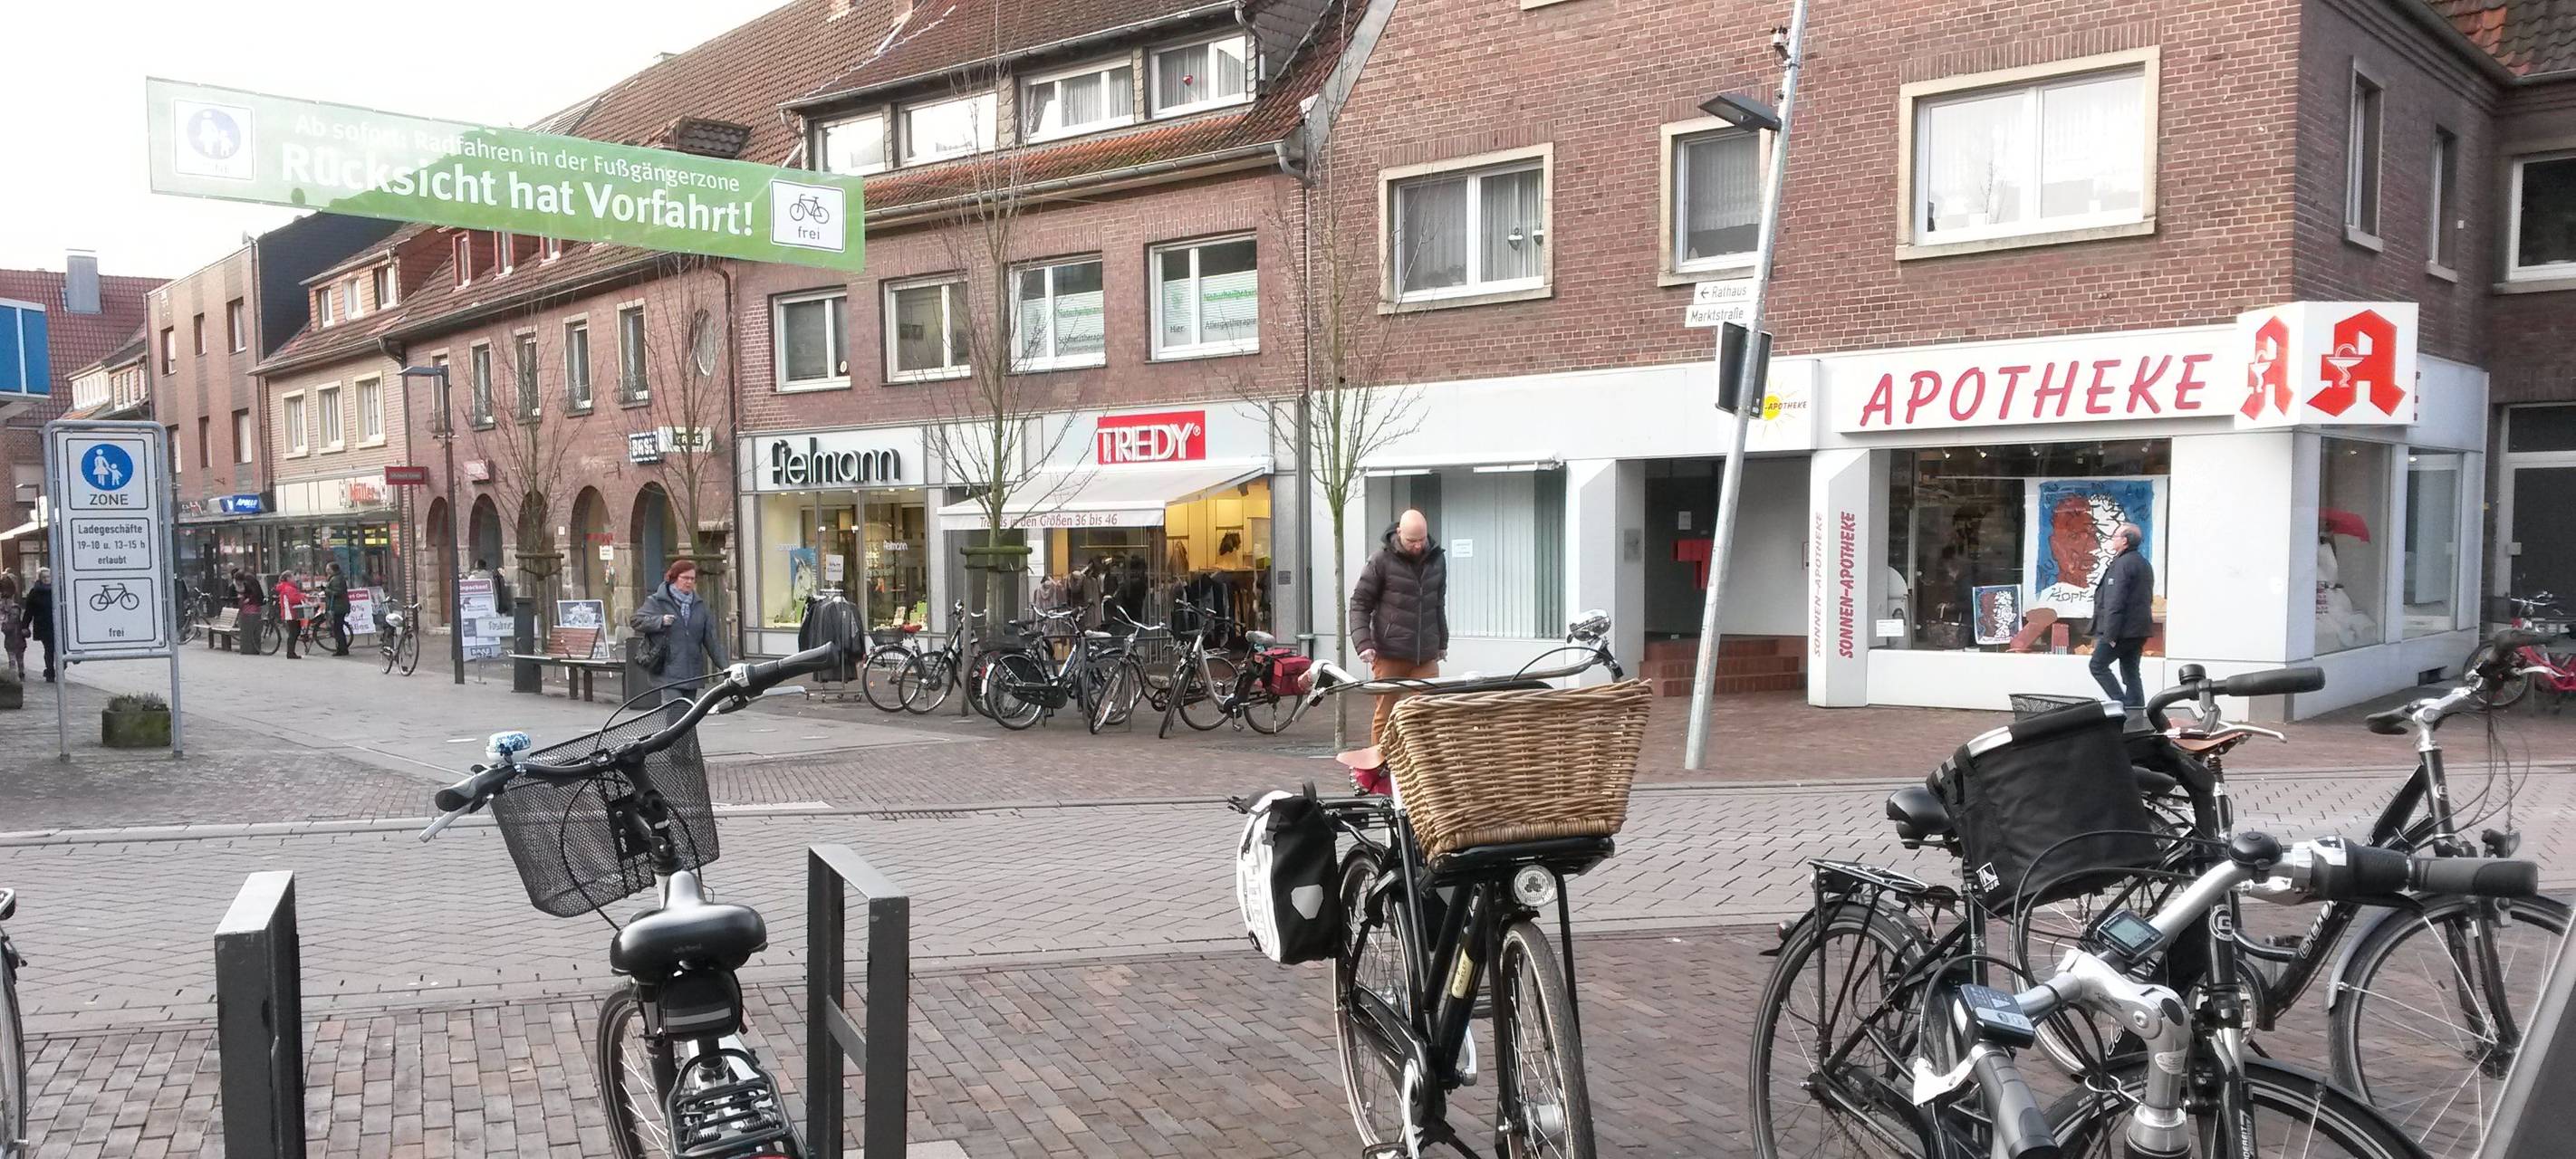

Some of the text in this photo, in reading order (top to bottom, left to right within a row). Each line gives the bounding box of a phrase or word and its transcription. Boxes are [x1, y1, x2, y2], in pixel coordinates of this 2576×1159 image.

[295, 113, 327, 138] Ab
[414, 129, 524, 164] Radfahren
[530, 145, 550, 168] in
[555, 148, 588, 172] der
[593, 154, 741, 193] Fußgängerzone
[281, 142, 754, 238] Rücksicht hat Vorfahrt!
[796, 226, 821, 241] frei
[1711, 285, 1747, 299] Rathaus
[1690, 307, 1745, 322] Marktstraße
[1860, 353, 2215, 427] APOTHEKE
[772, 436, 901, 485] fielmann
[89, 493, 130, 506] ZONE
[1020, 516, 1037, 528] den
[1040, 514, 1072, 527] Größen
[1075, 514, 1087, 526] 36
[1089, 513, 1102, 526] bis
[1104, 513, 1118, 526] 46
[78, 523, 143, 536] Ladegeschäfte
[139, 539, 146, 549] h
[97, 555, 128, 565] erlaubt
[1813, 512, 1823, 657] SONNEN-APOTHEKE
[1840, 511, 1856, 659] SONNEN-APOTHEKE
[108, 627, 125, 637] frei
